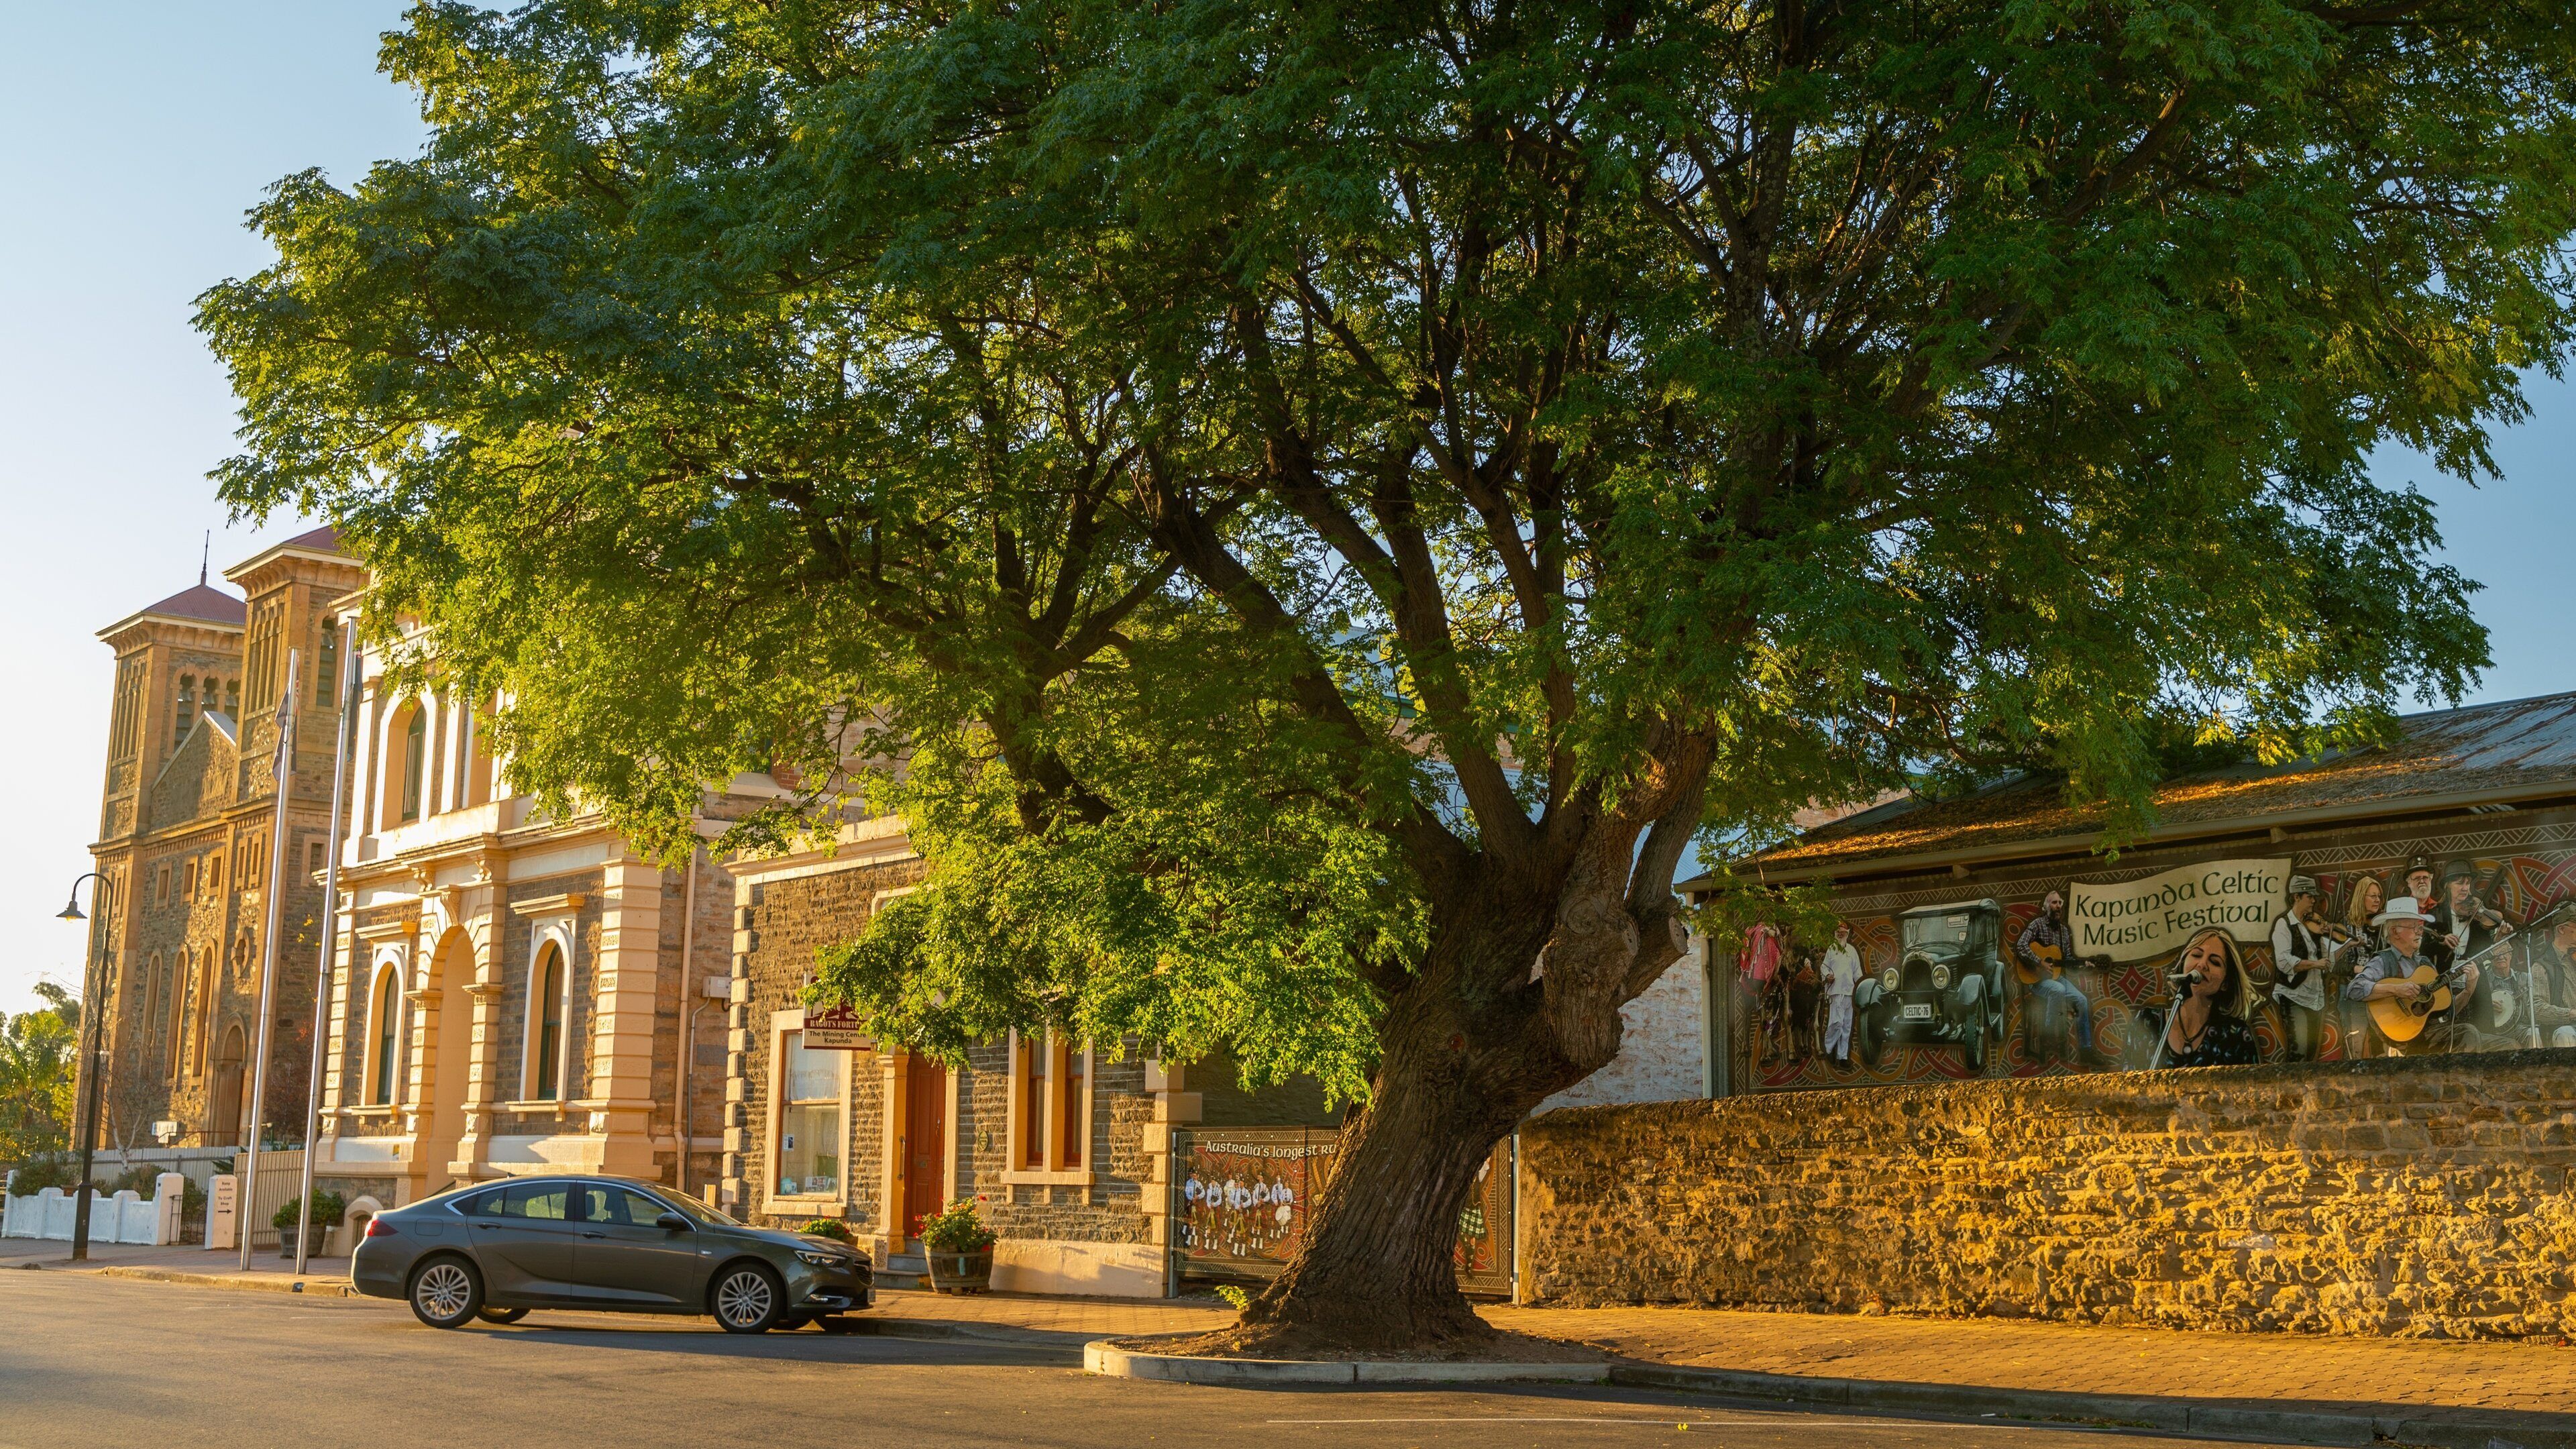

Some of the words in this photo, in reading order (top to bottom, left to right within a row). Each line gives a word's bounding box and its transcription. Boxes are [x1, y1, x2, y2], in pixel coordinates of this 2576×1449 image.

[2076, 882, 2196, 923] Kapunda
[2202, 869, 2279, 896] Celtic
[2084, 918, 2159, 946] Music
[2163, 900, 2268, 933] Festival
[838, 1020, 862, 1028] FORTU
[1205, 1140, 1270, 1157] Australia's
[1273, 1144, 1318, 1161] longest
